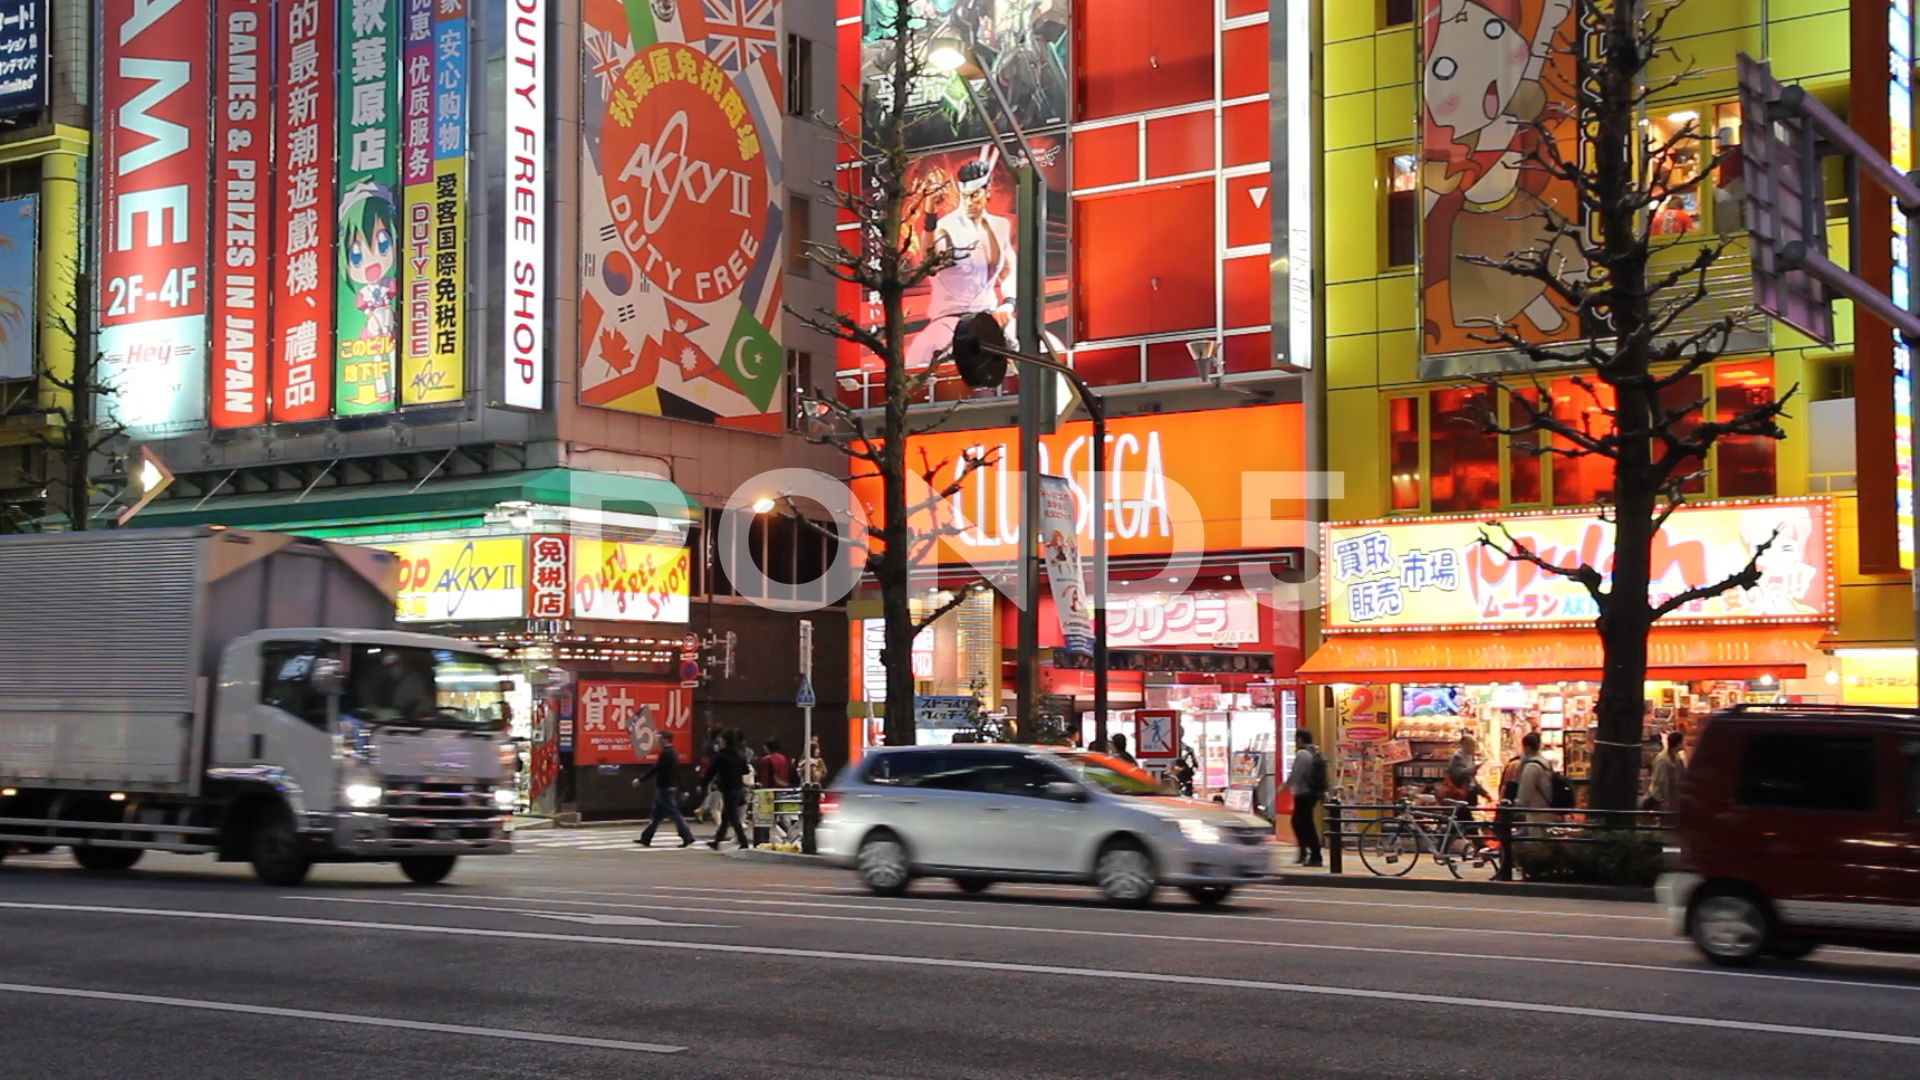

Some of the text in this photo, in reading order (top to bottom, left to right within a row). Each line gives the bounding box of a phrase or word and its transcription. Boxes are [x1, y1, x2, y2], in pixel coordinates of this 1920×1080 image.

[409, 55, 431, 178] 优质服务
[437, 29, 462, 153] 安心购物
[224, 11, 257, 413] GAMES & PRIZES IN JAPAN
[515, 126, 537, 244] FREE
[107, 266, 197, 317] 2F-4F
[410, 203, 432, 357] DUTY FREE
[435, 172, 458, 355] 愛客国際免税店
[610, 193, 760, 300] DUTY FREE
[126, 343, 172, 365] Hey
[341, 338, 395, 359] このビル
[513, 261, 536, 385] SHOP
[1063, 431, 1170, 540] SEGA
[535, 540, 566, 615] 免税店
[1337, 536, 1392, 579] 買取
[1350, 580, 1400, 618] 販売
[1402, 550, 1457, 591] 市場
[1483, 594, 1558, 618] ムーラン
[581, 686, 691, 731] 貸ホール
